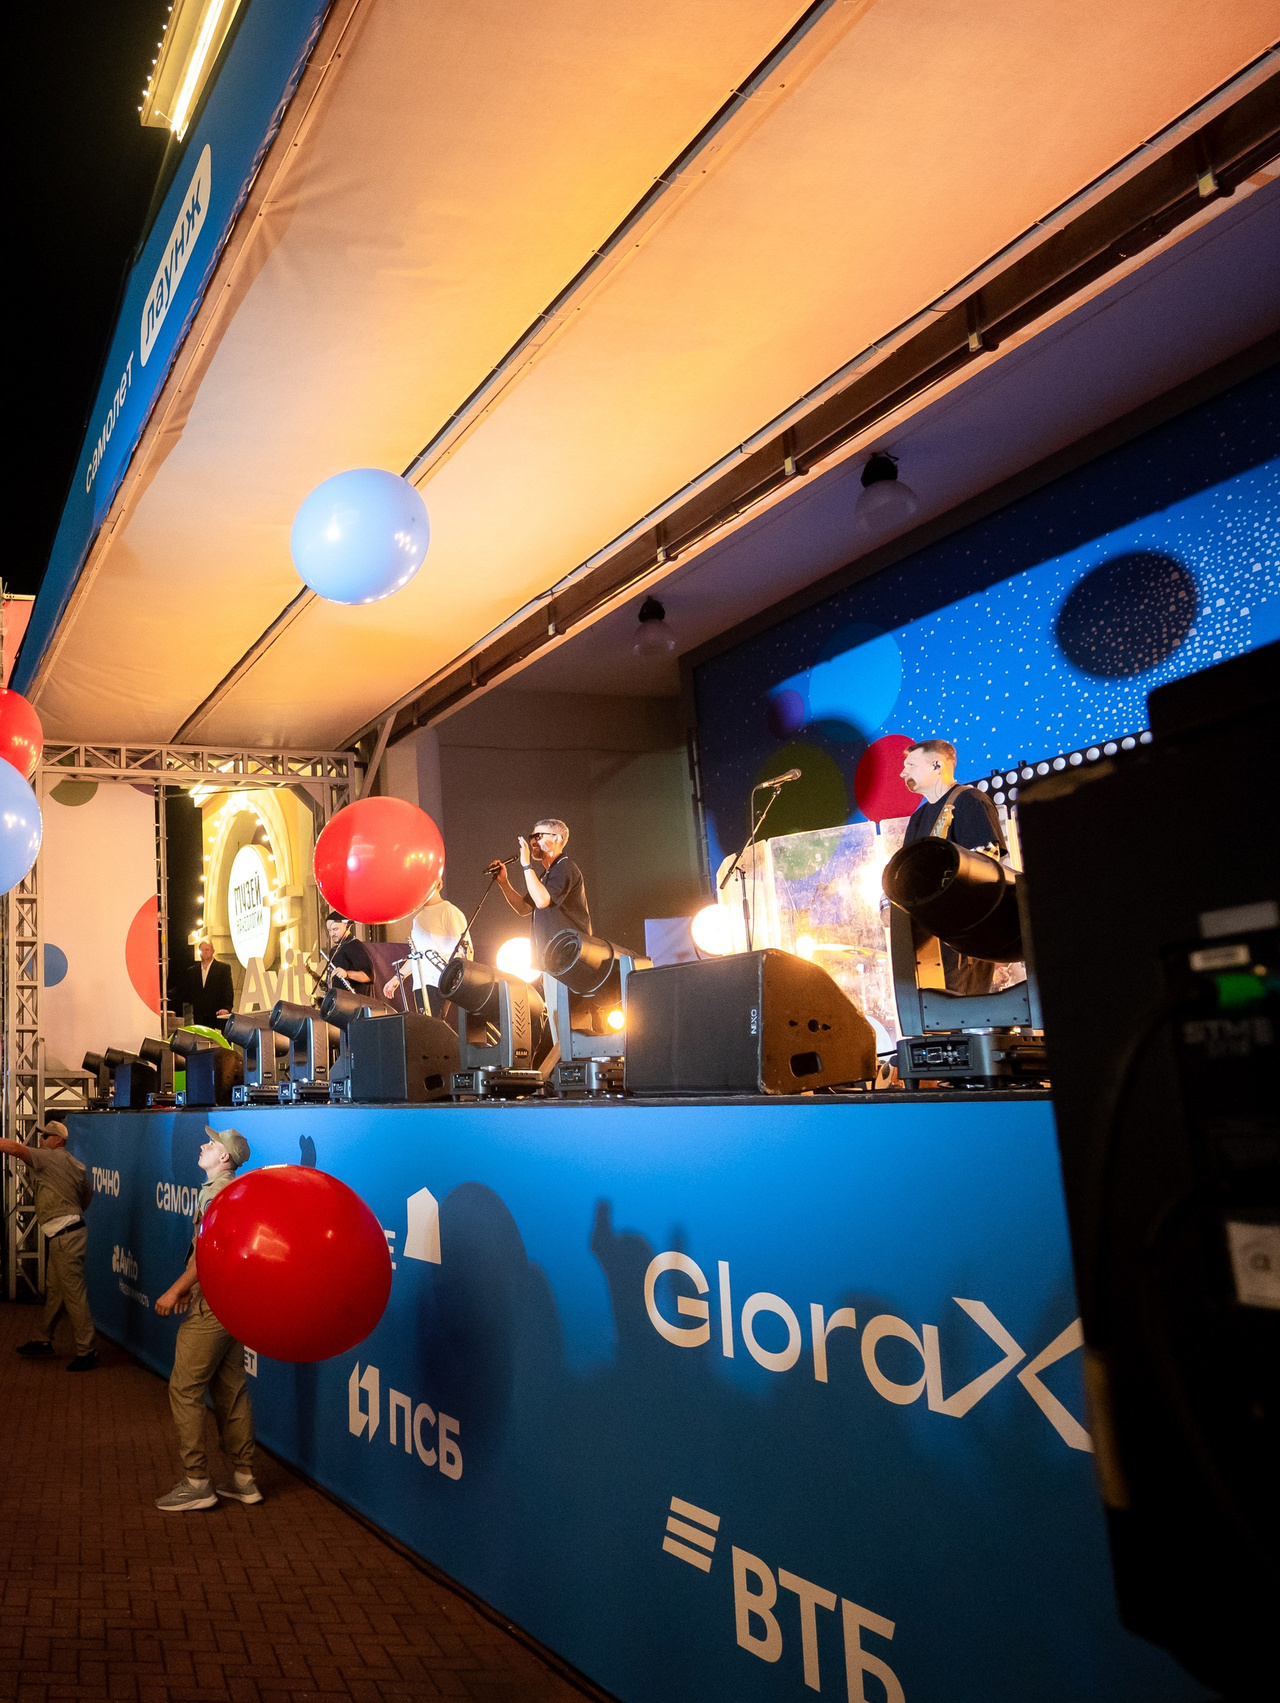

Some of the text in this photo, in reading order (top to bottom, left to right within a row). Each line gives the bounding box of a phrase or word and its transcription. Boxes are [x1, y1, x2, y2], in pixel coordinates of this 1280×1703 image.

[85, 176, 202, 493] самолет лаунж
[234, 871, 262, 916] МУЗЕЙ
[120, 1246, 139, 1282] Avito
[389, 1387, 463, 1481] ПСБ
[732, 1545, 907, 1703] ВТБ
